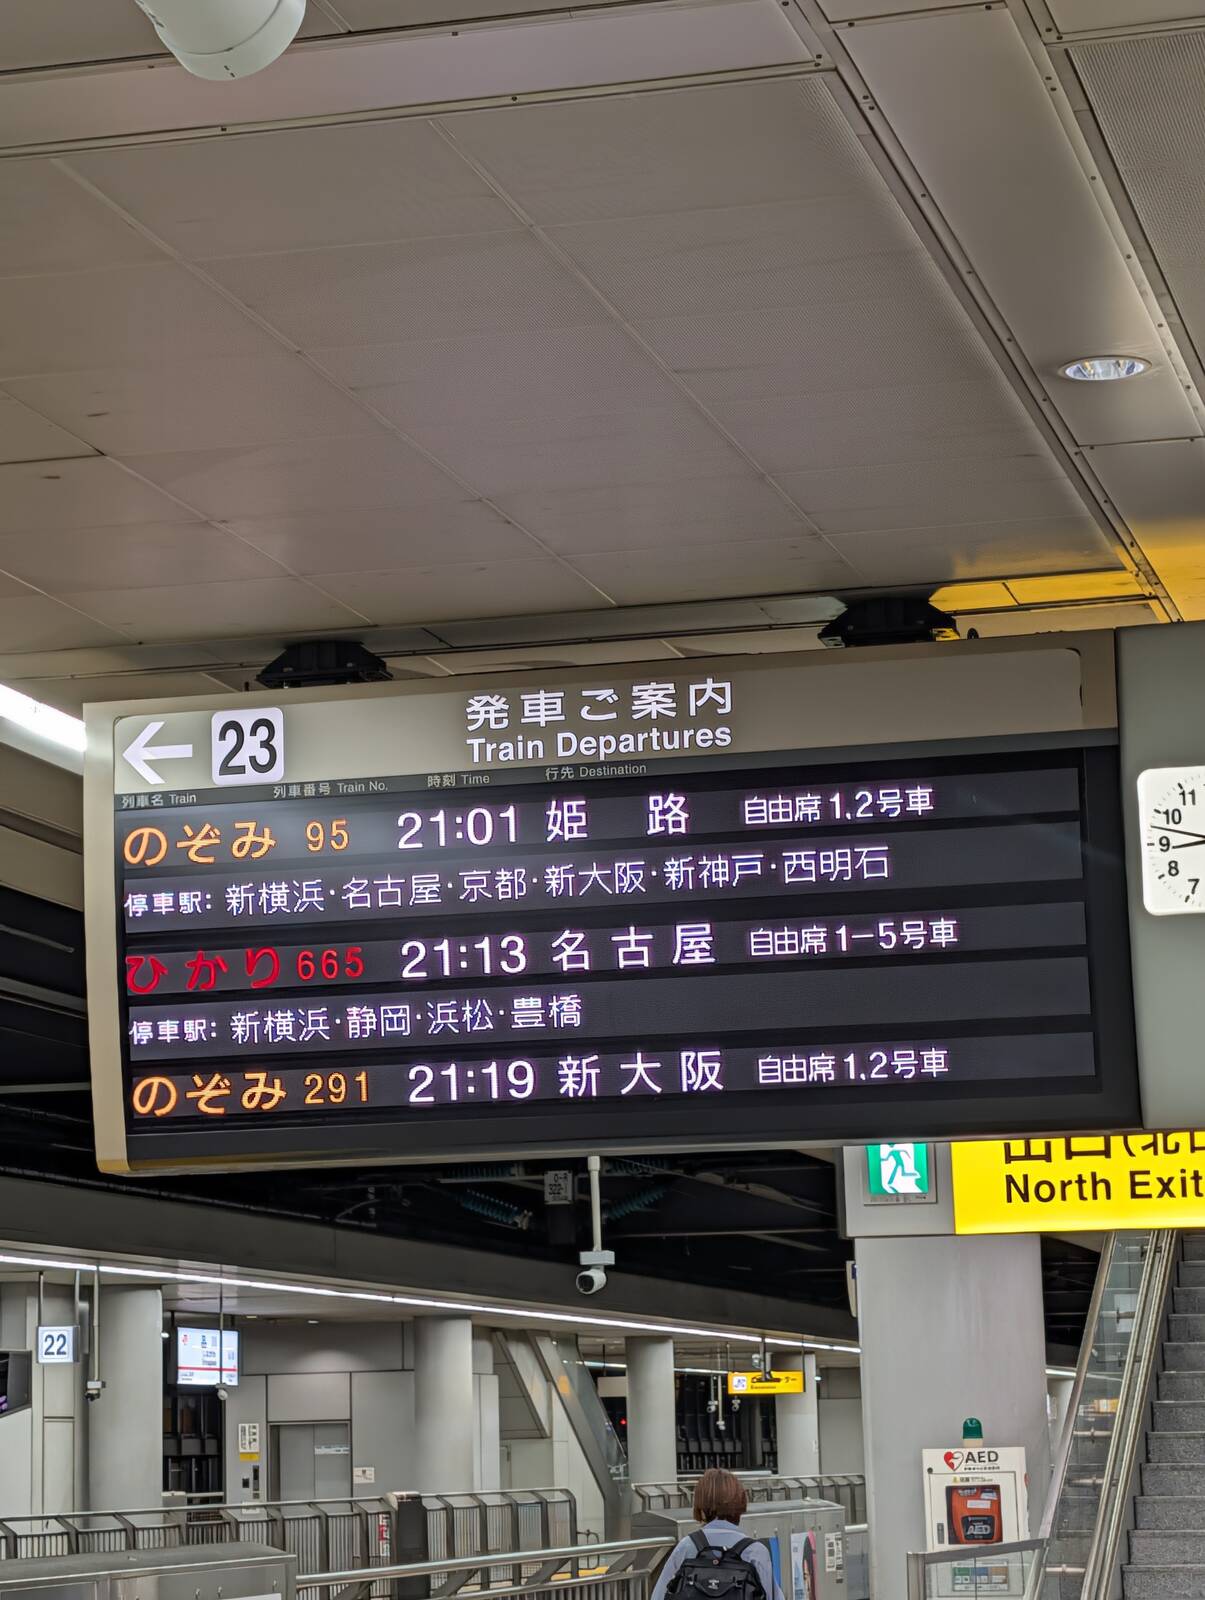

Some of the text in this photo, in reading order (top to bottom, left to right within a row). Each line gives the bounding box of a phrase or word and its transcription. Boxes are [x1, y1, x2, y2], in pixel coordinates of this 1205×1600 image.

[465, 678, 733, 732] 発車ご案内
[217, 718, 278, 776] 23
[466, 726, 733, 763] Train Departures
[427, 773, 490, 788] 時刻 Time
[545, 763, 647, 781] 行先 Destination
[273, 779, 389, 799] 列車番号 Train No.
[1179, 789, 1196, 806] 11
[121, 792, 197, 809] 列車名 Train
[1163, 808, 1182, 825] 10
[123, 821, 277, 866] のぞみ
[305, 819, 350, 852] 95
[396, 804, 518, 850] 21:01
[546, 793, 690, 843] 姫路
[1158, 835, 1171, 853] 9
[1167, 860, 1179, 877] 8
[1188, 878, 1200, 895] 7
[125, 947, 281, 994] ひかり
[296, 947, 365, 980] 665
[401, 934, 527, 979] 21:13
[551, 922, 716, 972] 名古屋
[132, 1071, 287, 1117] のぞみ
[303, 1071, 369, 1105] 291
[408, 1061, 535, 1103] 21:19
[558, 1050, 724, 1098] 新大阪
[1005, 1168, 1204, 1204] North Exit
[44, 1333, 67, 1356] 22
[965, 1451, 999, 1464] AED
[967, 1525, 991, 1535] AED
